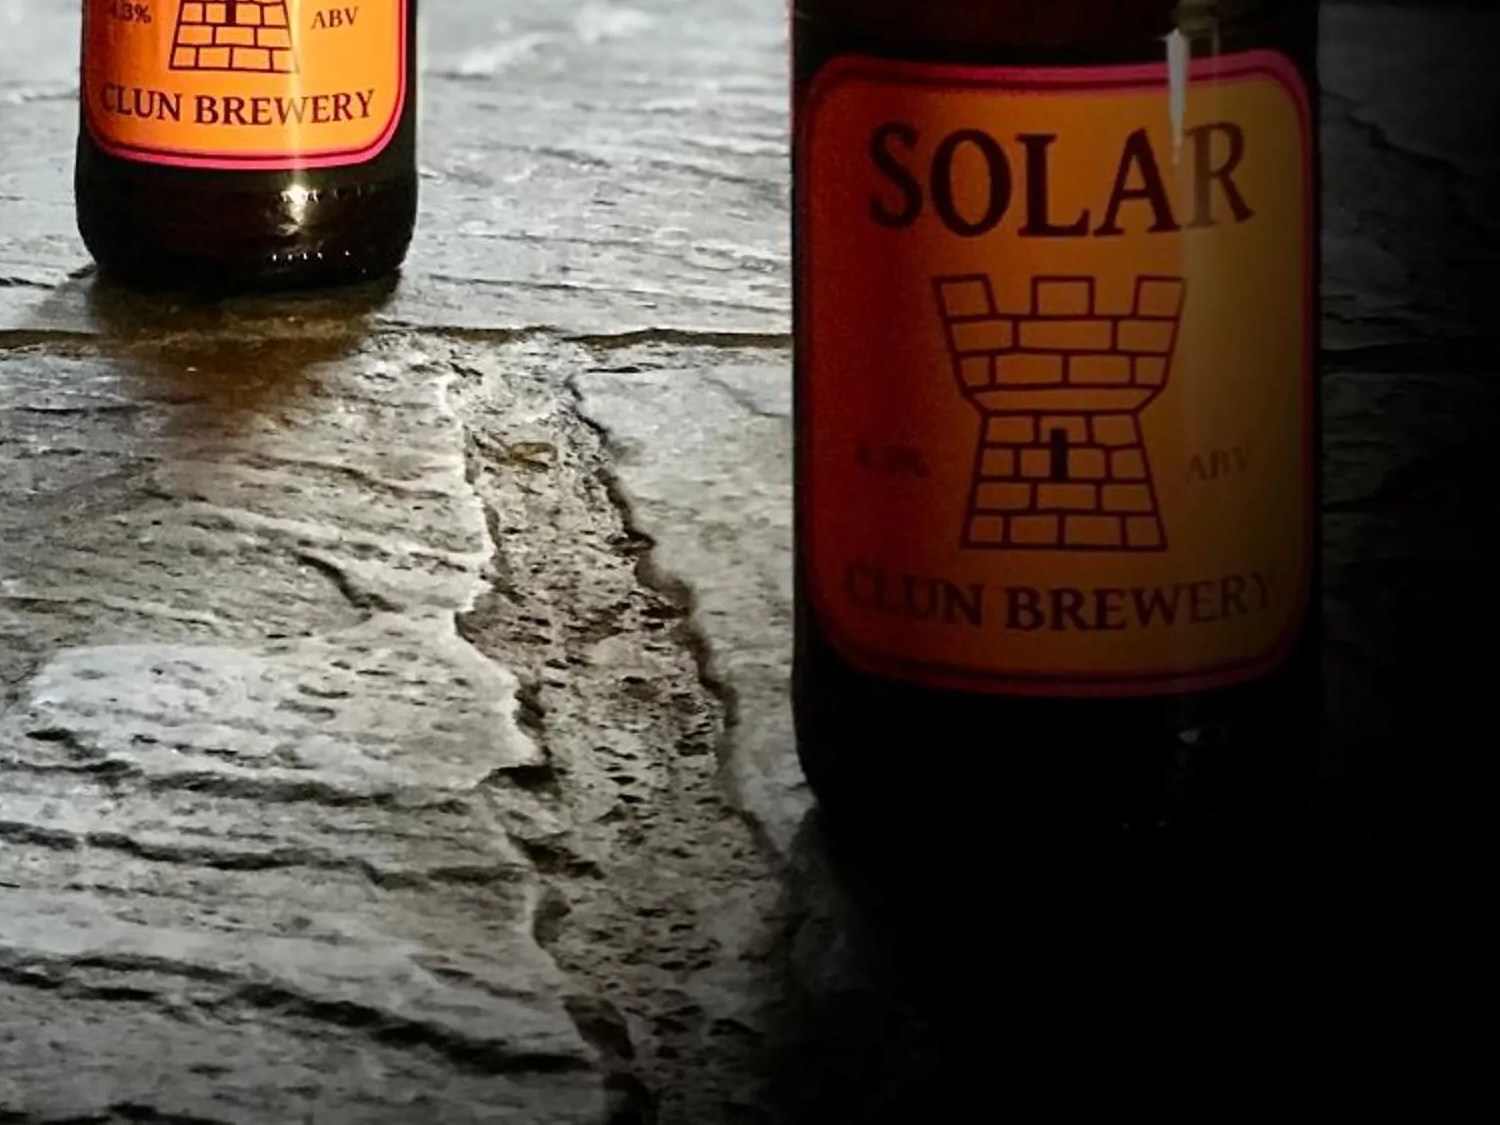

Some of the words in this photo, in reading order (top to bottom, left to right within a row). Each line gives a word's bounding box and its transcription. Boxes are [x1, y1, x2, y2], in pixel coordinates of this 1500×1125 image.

[310, 6, 359, 30] ABV
[100, 86, 184, 123] CLUN
[194, 88, 376, 127] BREWERY
[866, 120, 1258, 238] SOLAR
